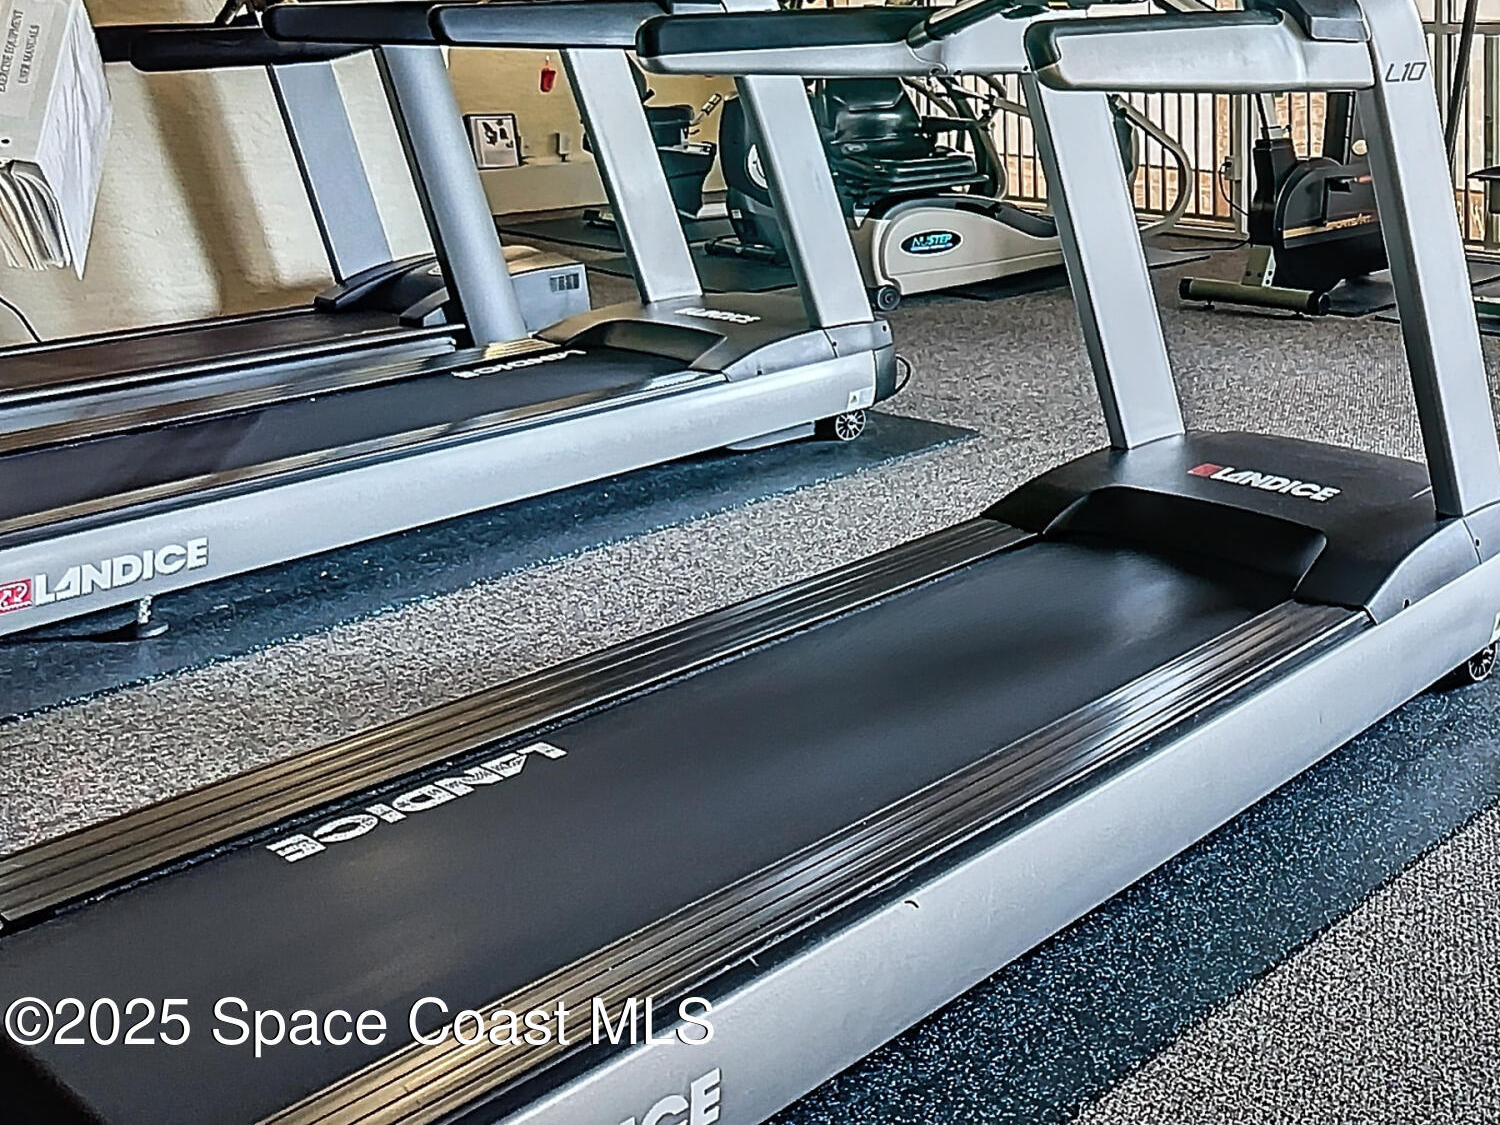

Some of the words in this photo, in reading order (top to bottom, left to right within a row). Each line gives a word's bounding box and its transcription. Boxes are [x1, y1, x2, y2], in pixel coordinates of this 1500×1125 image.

[1385, 61, 1427, 82] L10
[1210, 466, 1342, 502] LANDICE
[35, 537, 209, 607] LANDICE
[266, 741, 568, 864] LANDICE
